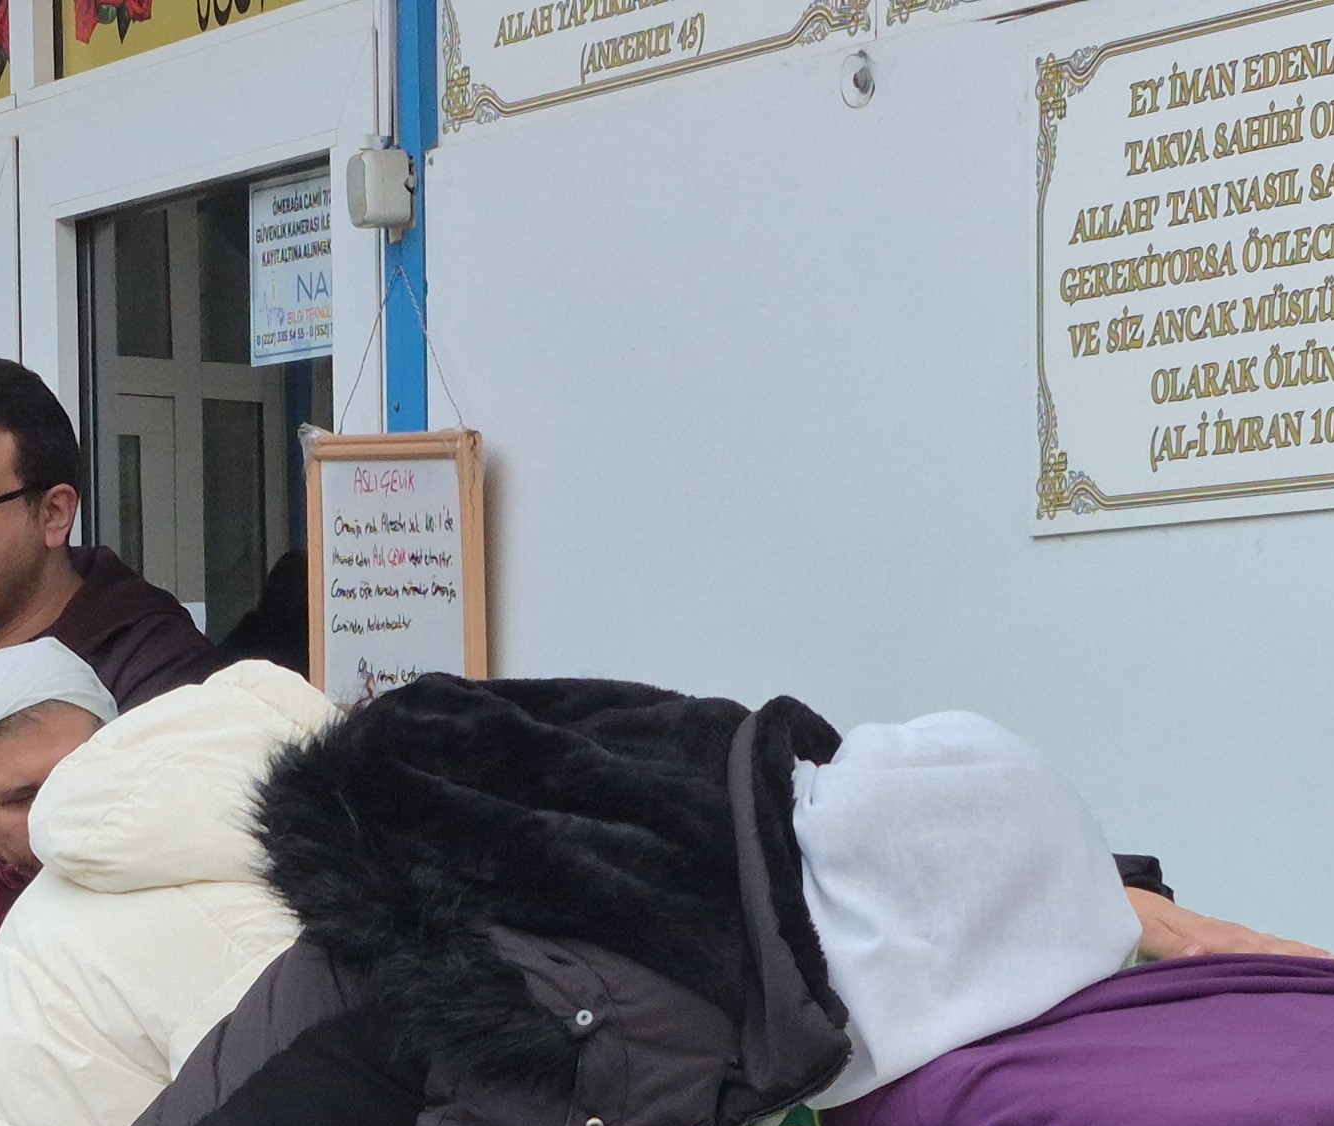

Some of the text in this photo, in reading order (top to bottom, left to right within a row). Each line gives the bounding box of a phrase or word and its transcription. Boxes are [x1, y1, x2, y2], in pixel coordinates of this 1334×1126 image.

[493, 3, 555, 48] ALLAH
[580, 11, 706, 84] (ANKEBUT 45)
[1127, 76, 1165, 119] EY
[1166, 61, 1239, 111] İMAN
[1124, 127, 1209, 177] TAKVA
[1212, 94, 1306, 160] SAHİBİ
[1167, 184, 1220, 227] TAN
[1224, 168, 1305, 218] NASIL
[297, 268, 332, 303] NA
[1059, 241, 1237, 306] GEREKİYORSA
[1067, 320, 1101, 358] VE
[1106, 305, 1145, 354] SİZ
[1147, 300, 1239, 348] ANCAK
[1150, 355, 1259, 405] OLARAK
[1149, 411, 1209, 473] (AL-İ
[1212, 407, 1305, 457] İMRAN
